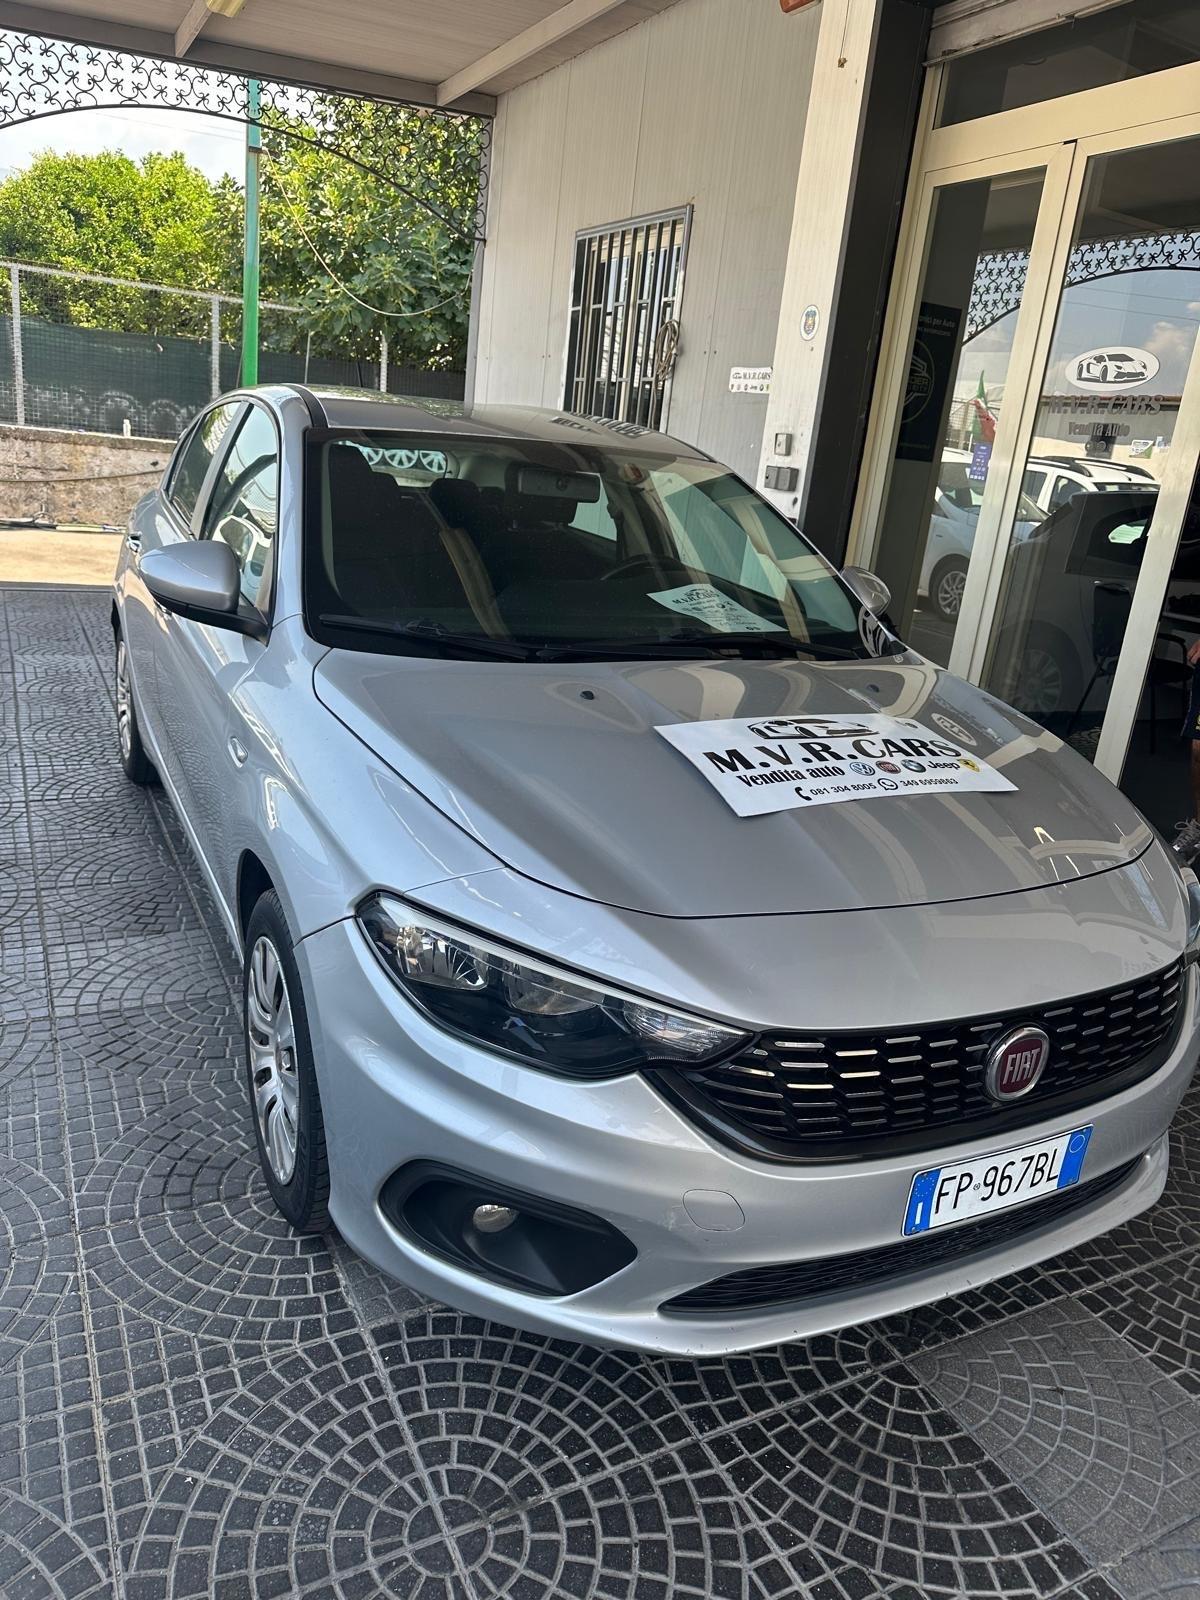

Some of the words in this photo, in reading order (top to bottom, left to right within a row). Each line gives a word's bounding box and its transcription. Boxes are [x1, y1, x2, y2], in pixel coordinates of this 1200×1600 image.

[806, 764, 846, 779] auto
[927, 760, 961, 770] Jeep
[809, 786, 830, 795] 081
[831, 784, 851, 793] 304
[851, 782, 877, 791] 8005
[900, 779, 919, 787] 349
[1003, 1047, 1041, 1085] FIAT
